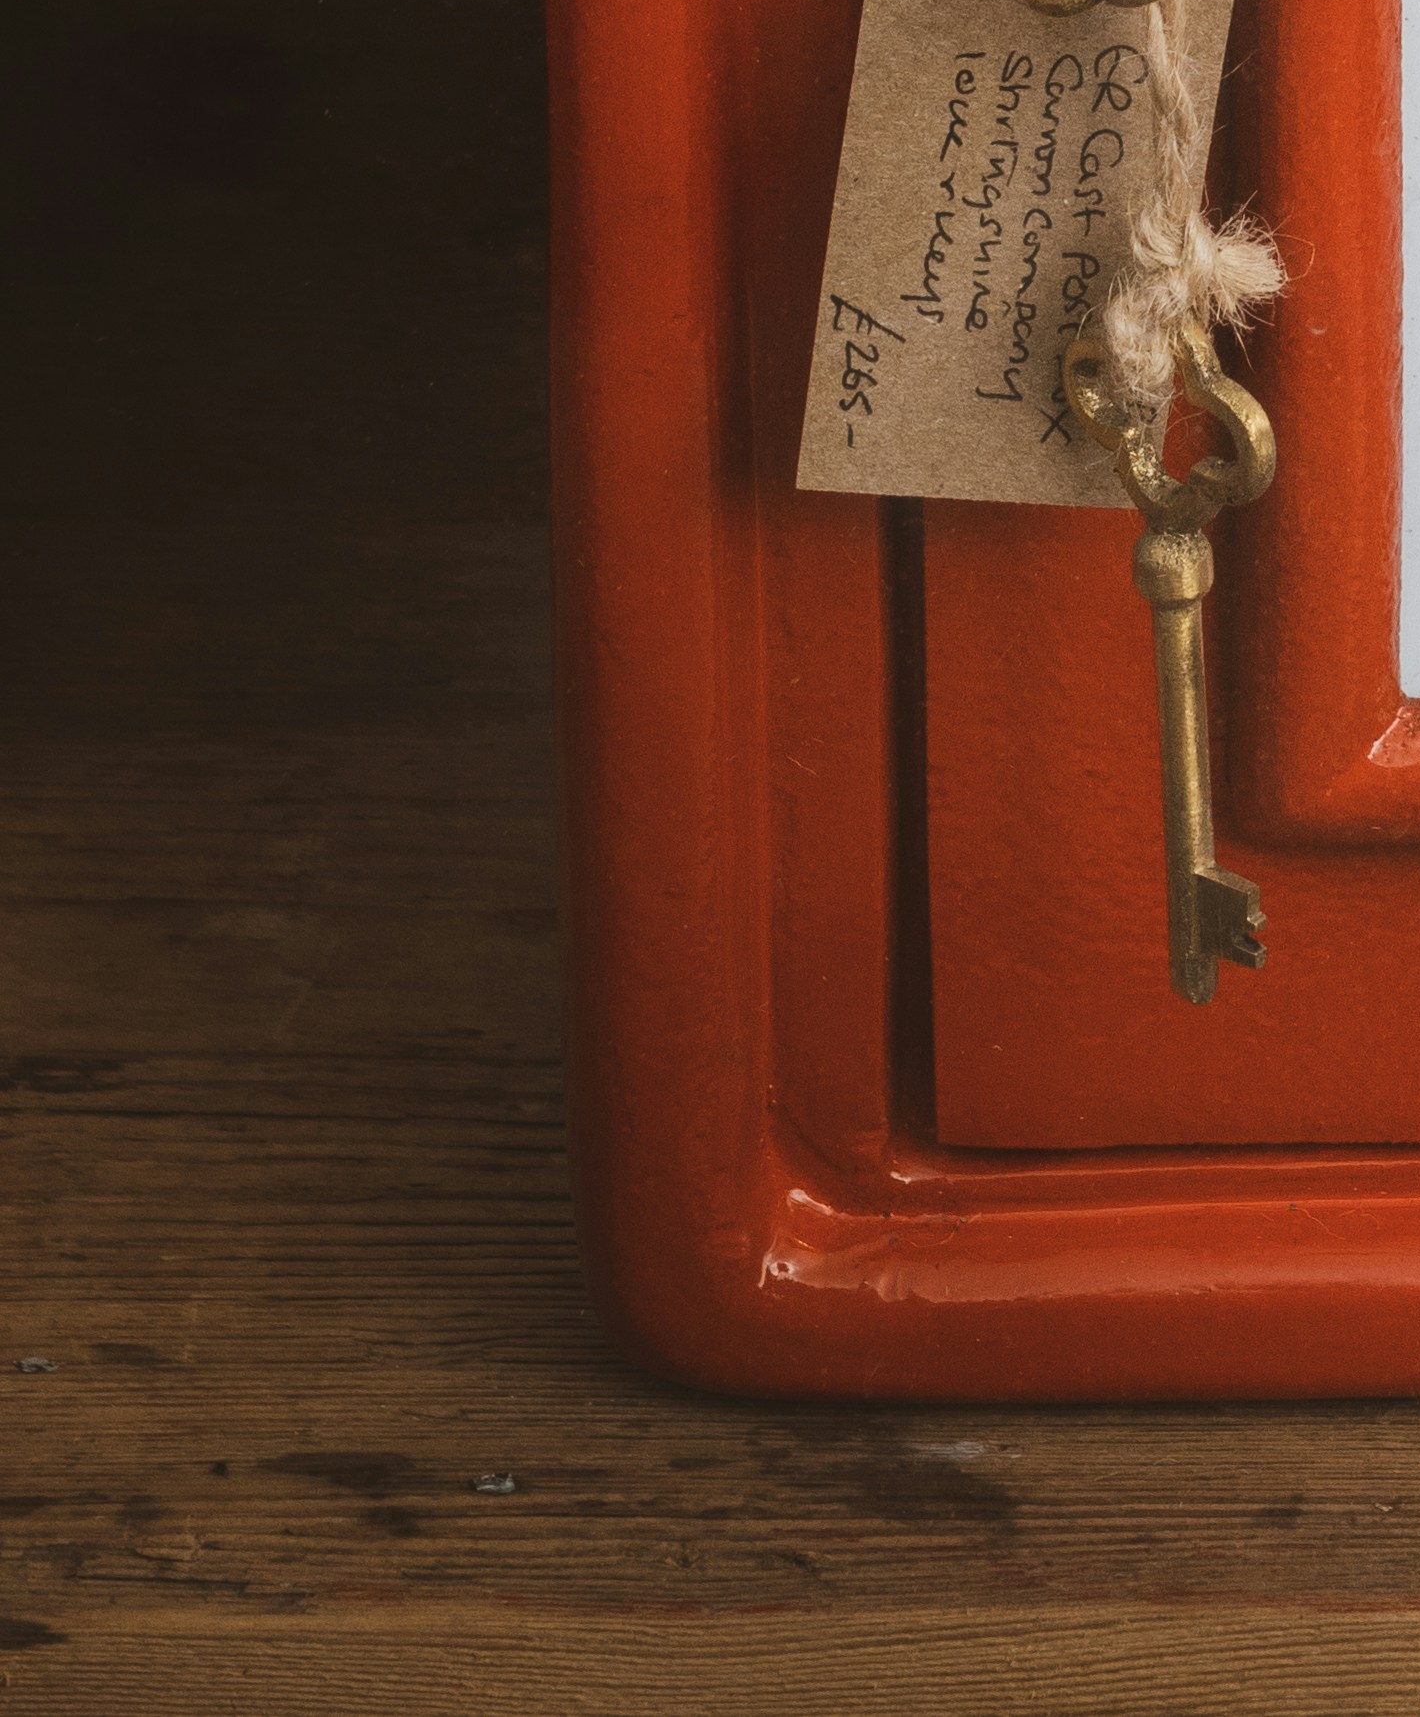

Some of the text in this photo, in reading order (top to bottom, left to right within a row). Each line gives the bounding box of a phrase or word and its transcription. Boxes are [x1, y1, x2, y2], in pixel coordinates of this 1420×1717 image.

[975, 53, 1084, 403] Carron Company
[1072, 128, 1125, 237] Cast
